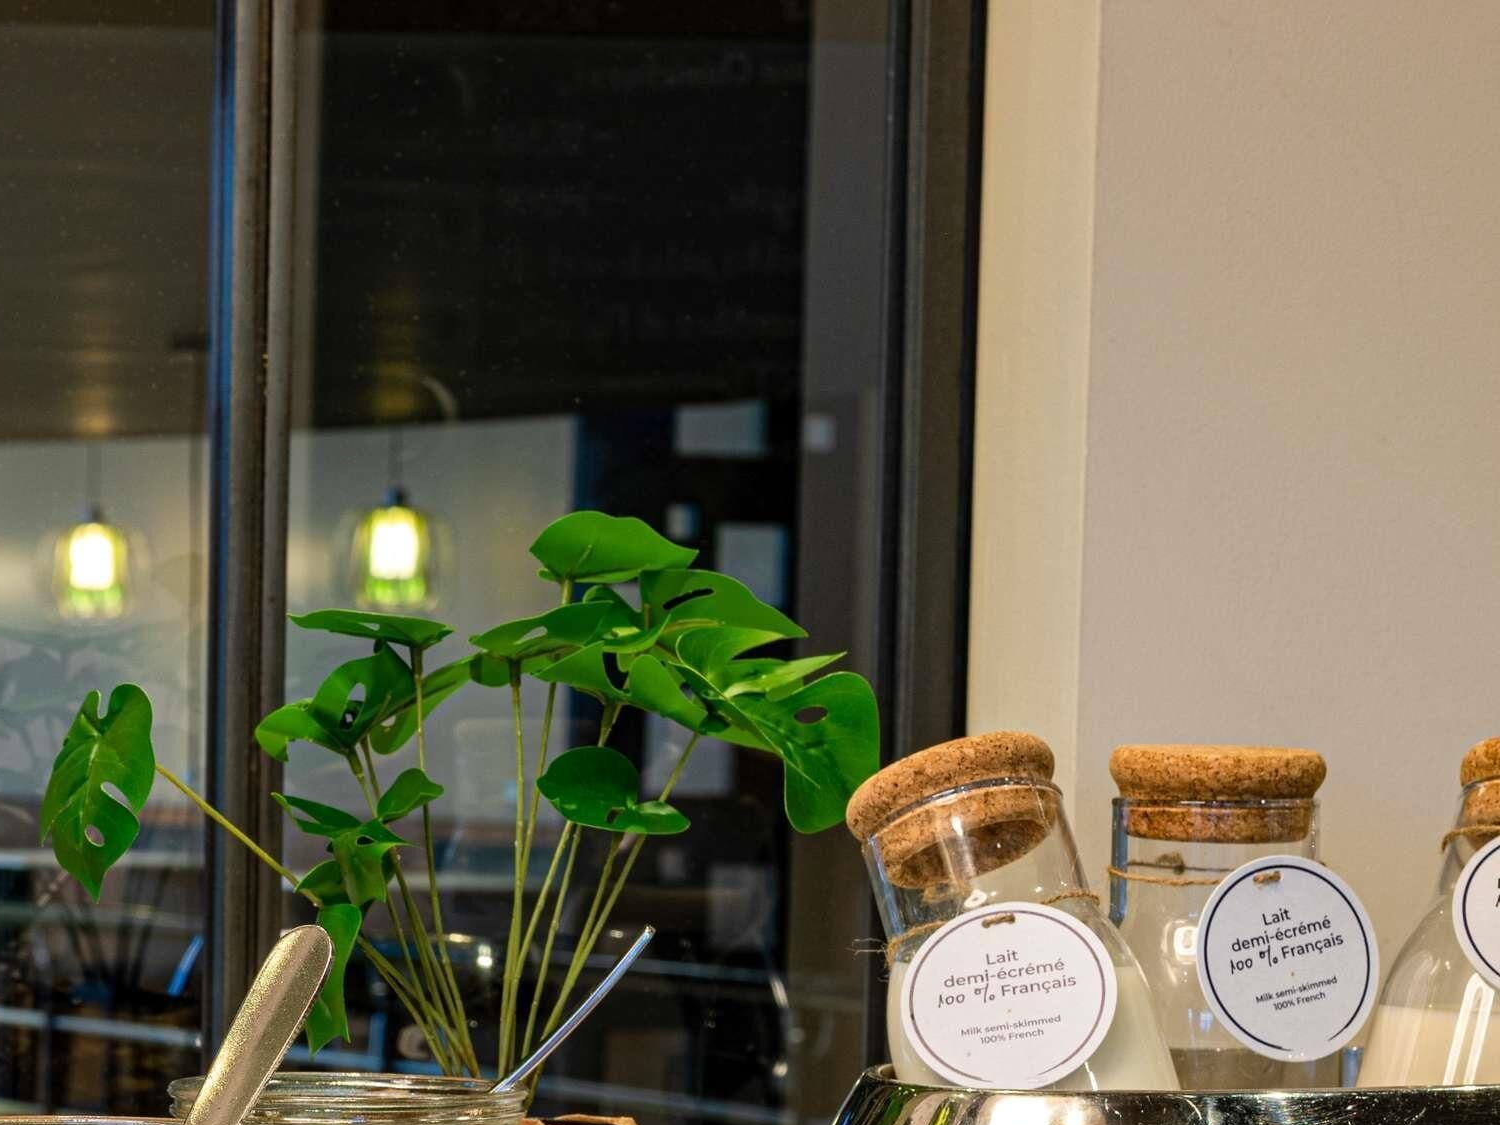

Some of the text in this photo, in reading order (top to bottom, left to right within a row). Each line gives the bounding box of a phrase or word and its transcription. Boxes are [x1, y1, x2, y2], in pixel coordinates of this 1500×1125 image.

[1262, 908, 1291, 926] Lait
[1231, 915, 1332, 952] demi-écrémé
[985, 949, 1020, 966] Lait
[1230, 933, 1344, 974] 100 % Français
[943, 958, 1065, 988] demi-écrémé
[937, 974, 1077, 1008] 100 % Français
[1255, 976, 1338, 1004] Milk semi-skimmed
[1296, 991, 1326, 1005] French
[960, 1014, 1062, 1037] Milk semi-skimmed
[1008, 1027, 1045, 1041] French
